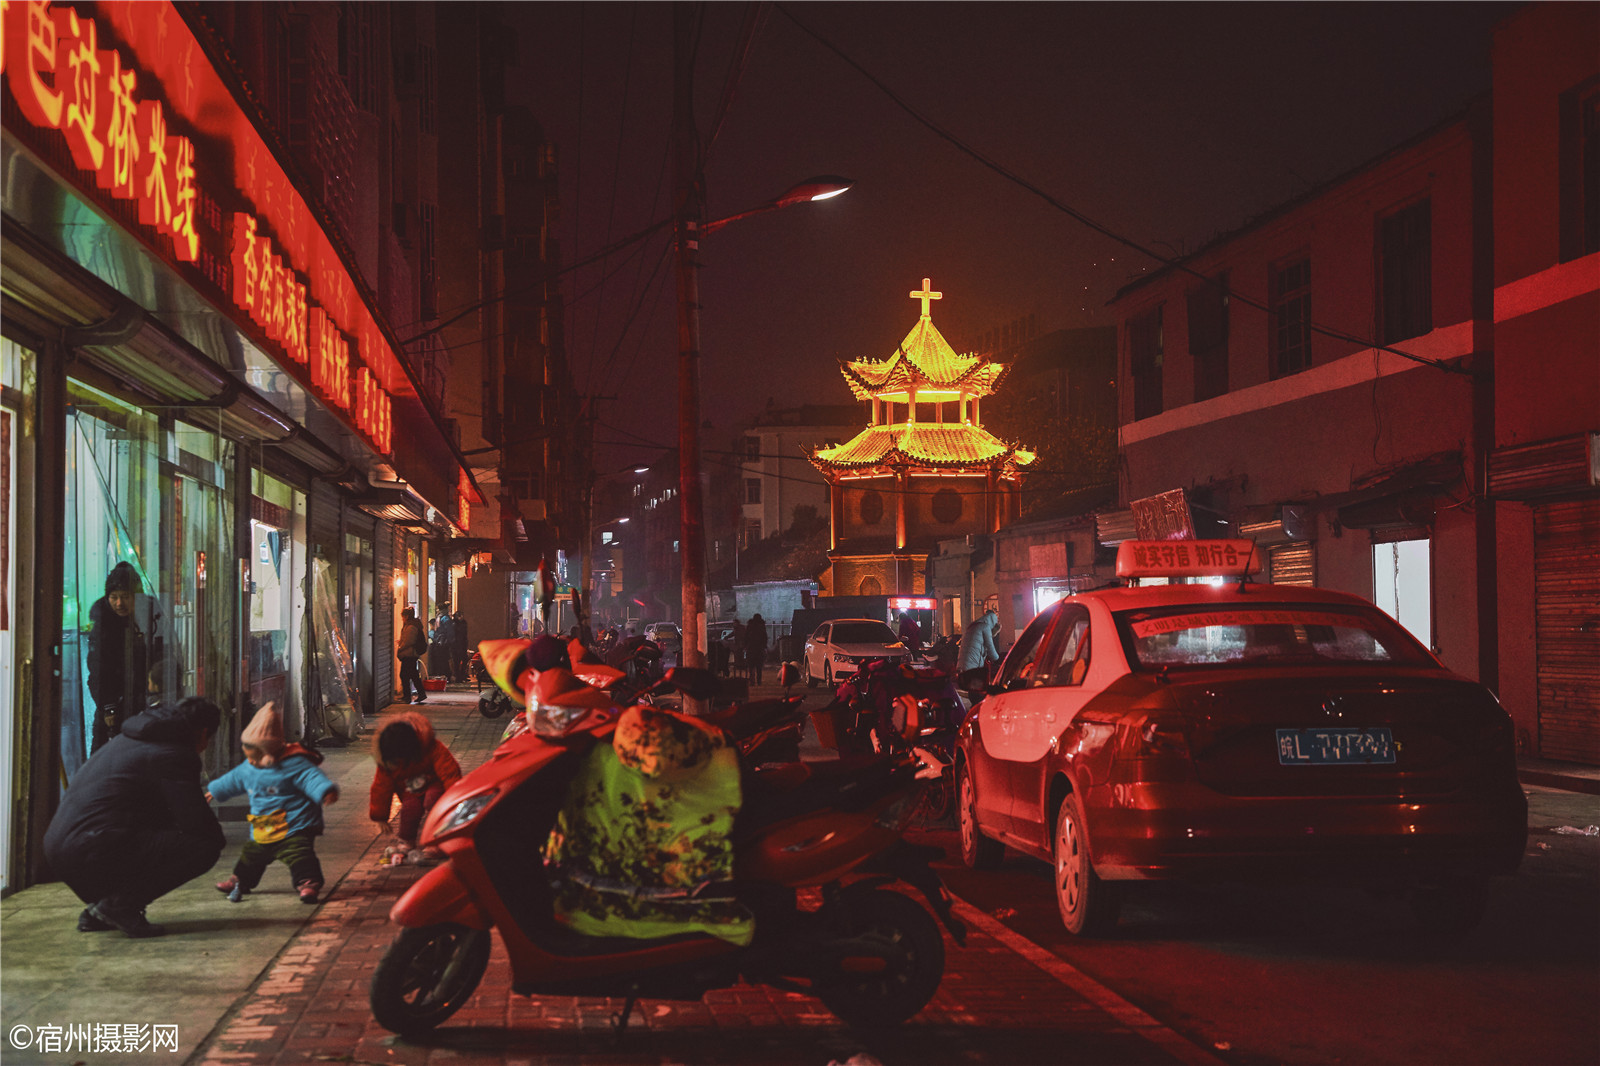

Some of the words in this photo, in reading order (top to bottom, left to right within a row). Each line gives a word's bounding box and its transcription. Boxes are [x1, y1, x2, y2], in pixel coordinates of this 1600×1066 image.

[0, 0, 200, 262] 色过桥米线
[1133, 545, 1190, 567] 诚实守信
[1195, 544, 1251, 566] 知行合一
